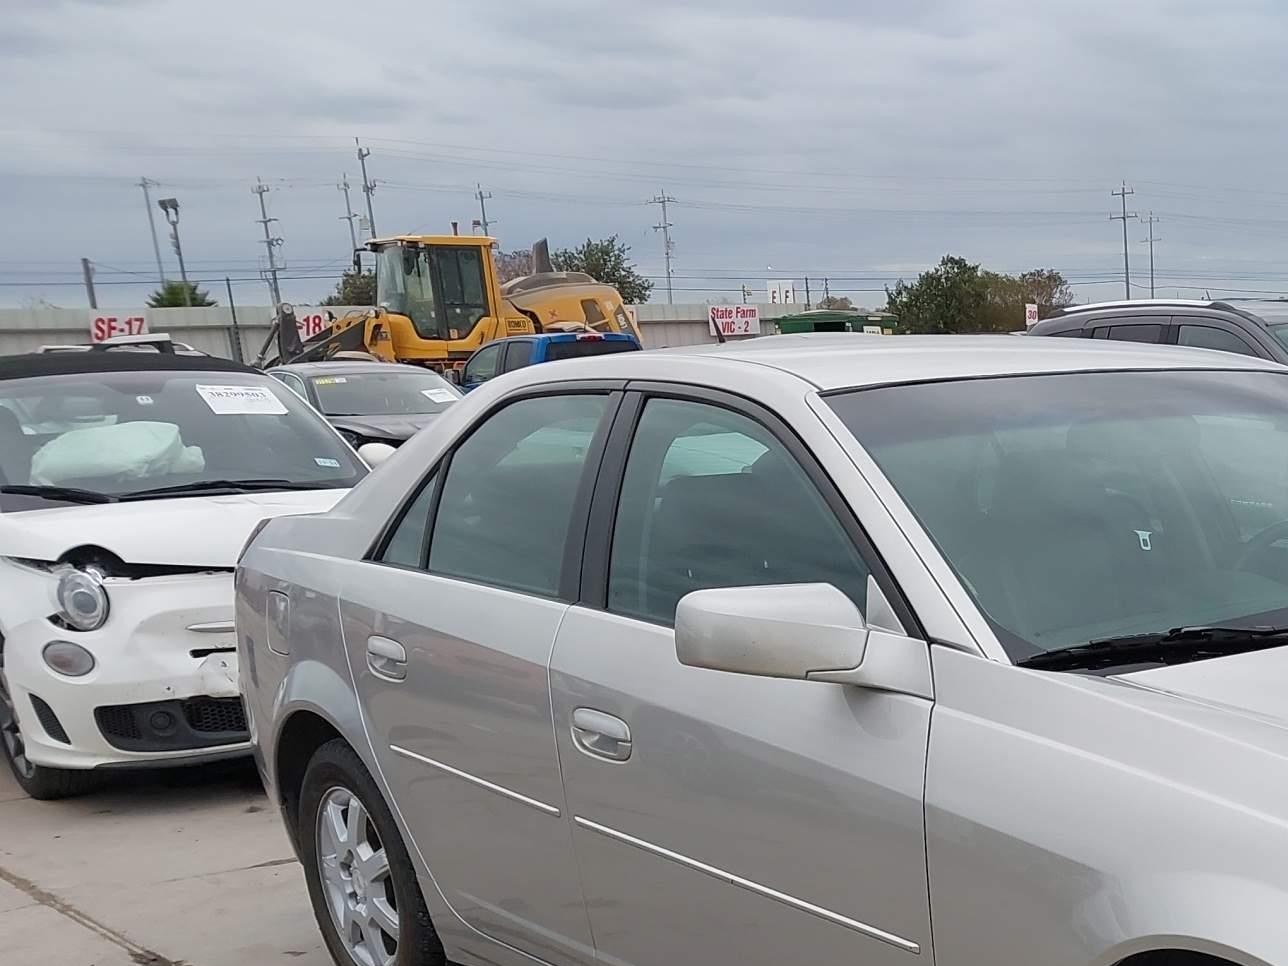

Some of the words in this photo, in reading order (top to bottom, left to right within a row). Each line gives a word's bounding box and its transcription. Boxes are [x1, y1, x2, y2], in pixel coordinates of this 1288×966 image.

[710, 306, 733, 319] State
[735, 306, 757, 319] Farm
[1027, 310, 1037, 320] 30
[94, 317, 145, 341] SF-17
[721, 321, 736, 333] VIC
[743, 320, 750, 333] 2
